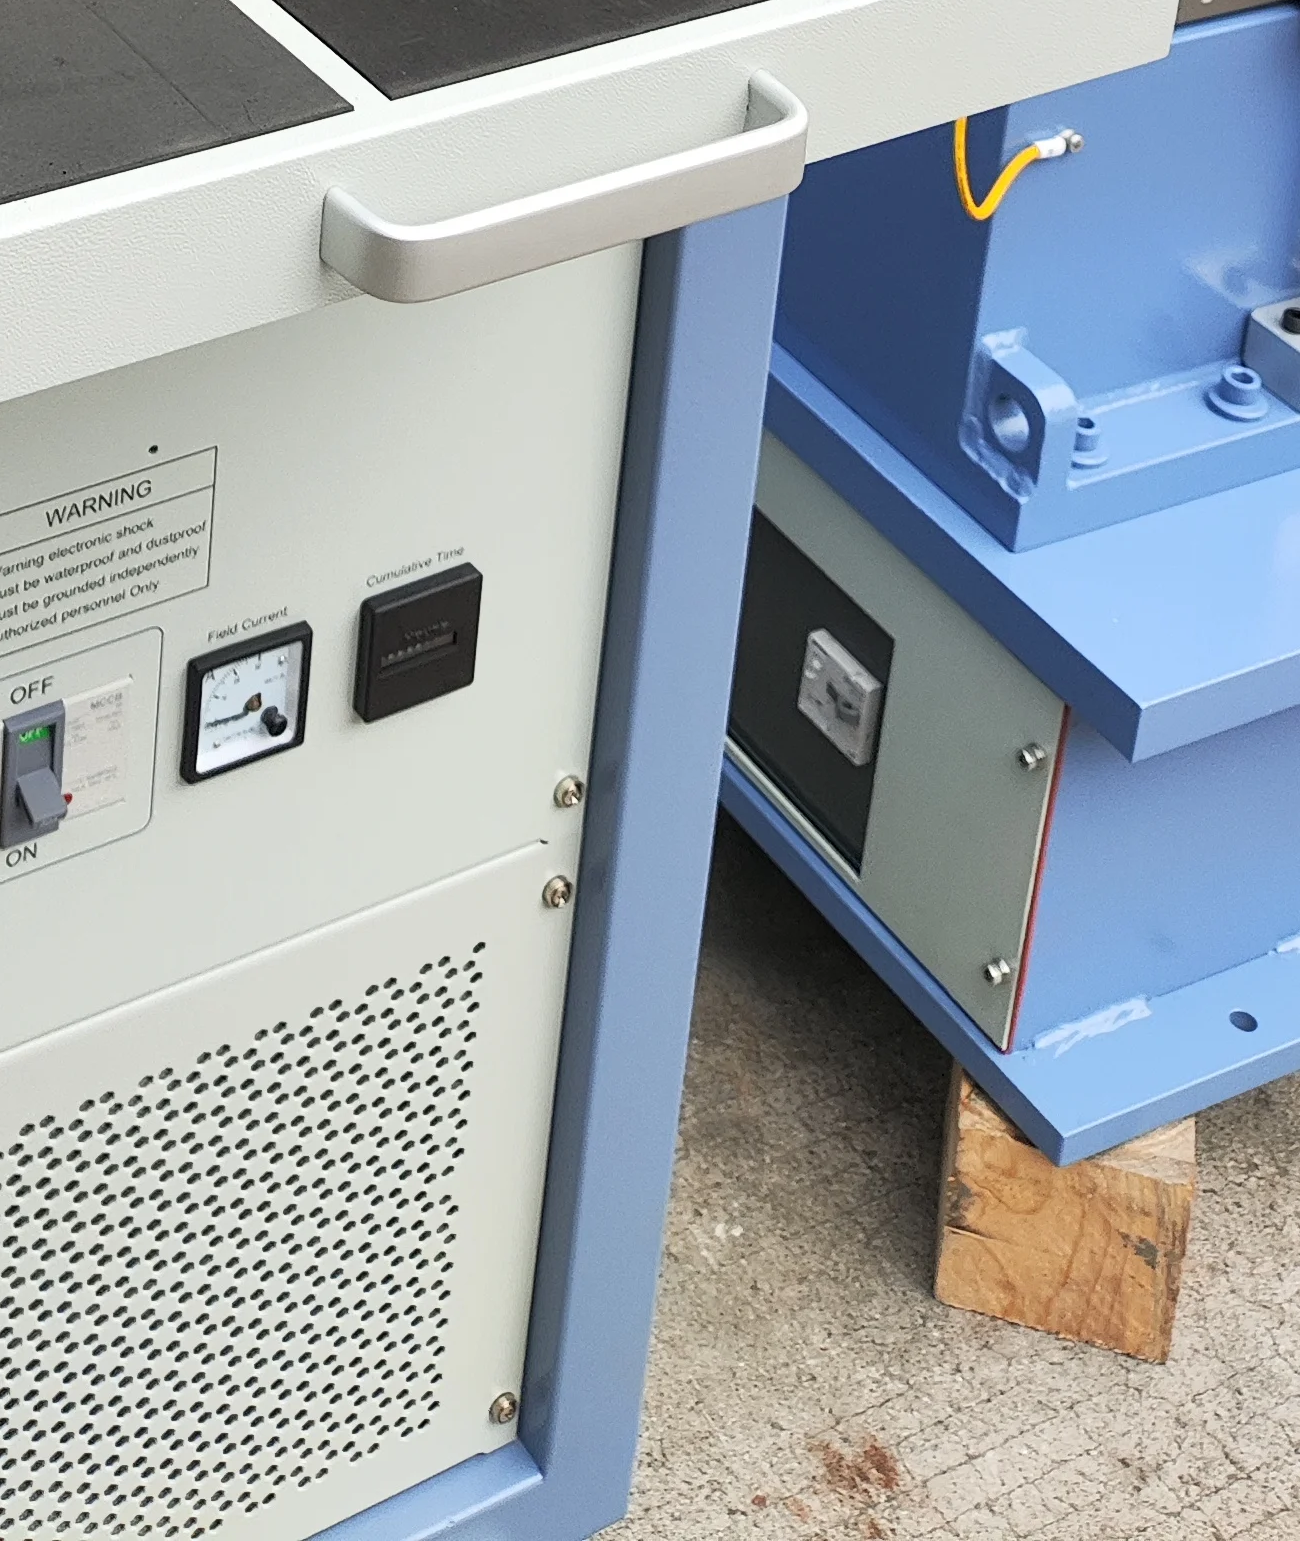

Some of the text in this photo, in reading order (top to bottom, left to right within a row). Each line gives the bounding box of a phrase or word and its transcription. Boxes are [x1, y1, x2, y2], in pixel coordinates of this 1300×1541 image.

[45, 479, 152, 527] WARNING
[23, 578, 40, 591] be
[44, 550, 115, 584] waterproof
[118, 542, 142, 560] and
[146, 520, 207, 551] dustproof
[48, 534, 112, 561] electronic
[116, 517, 154, 539] shock
[22, 599, 39, 613] be
[43, 576, 105, 608] grounded
[110, 545, 200, 582] independently
[366, 547, 465, 588] Cumulative Time
[61, 592, 126, 624] personnel
[130, 580, 160, 598] Only
[207, 606, 288, 644] Field Current
[10, 675, 54, 705] OFF
[6, 842, 38, 868] ON
